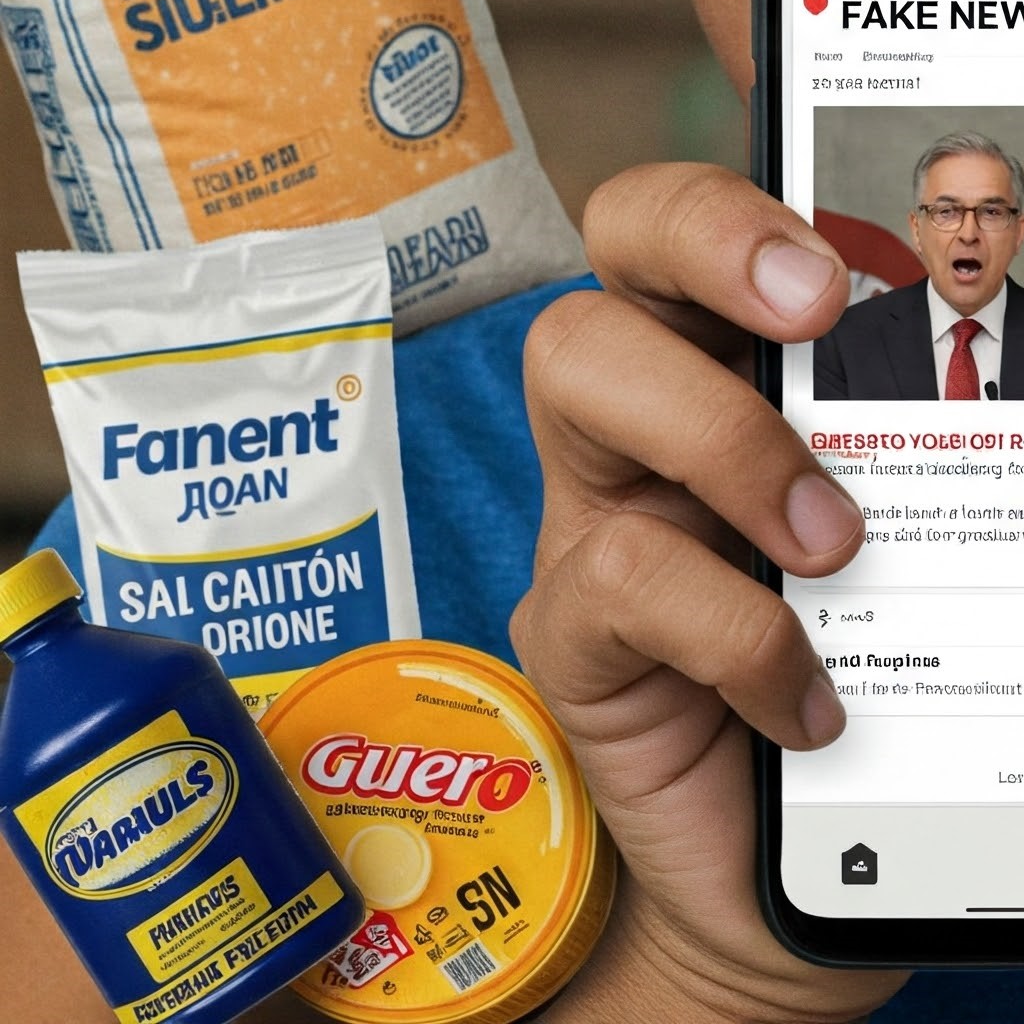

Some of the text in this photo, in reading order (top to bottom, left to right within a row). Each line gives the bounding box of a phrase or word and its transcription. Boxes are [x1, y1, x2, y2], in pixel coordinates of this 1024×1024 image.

[842, 1, 938, 29] FAKE
[103, 398, 339, 480] Fanent
[301, 732, 532, 812] Guero
[456, 865, 521, 933] SN
